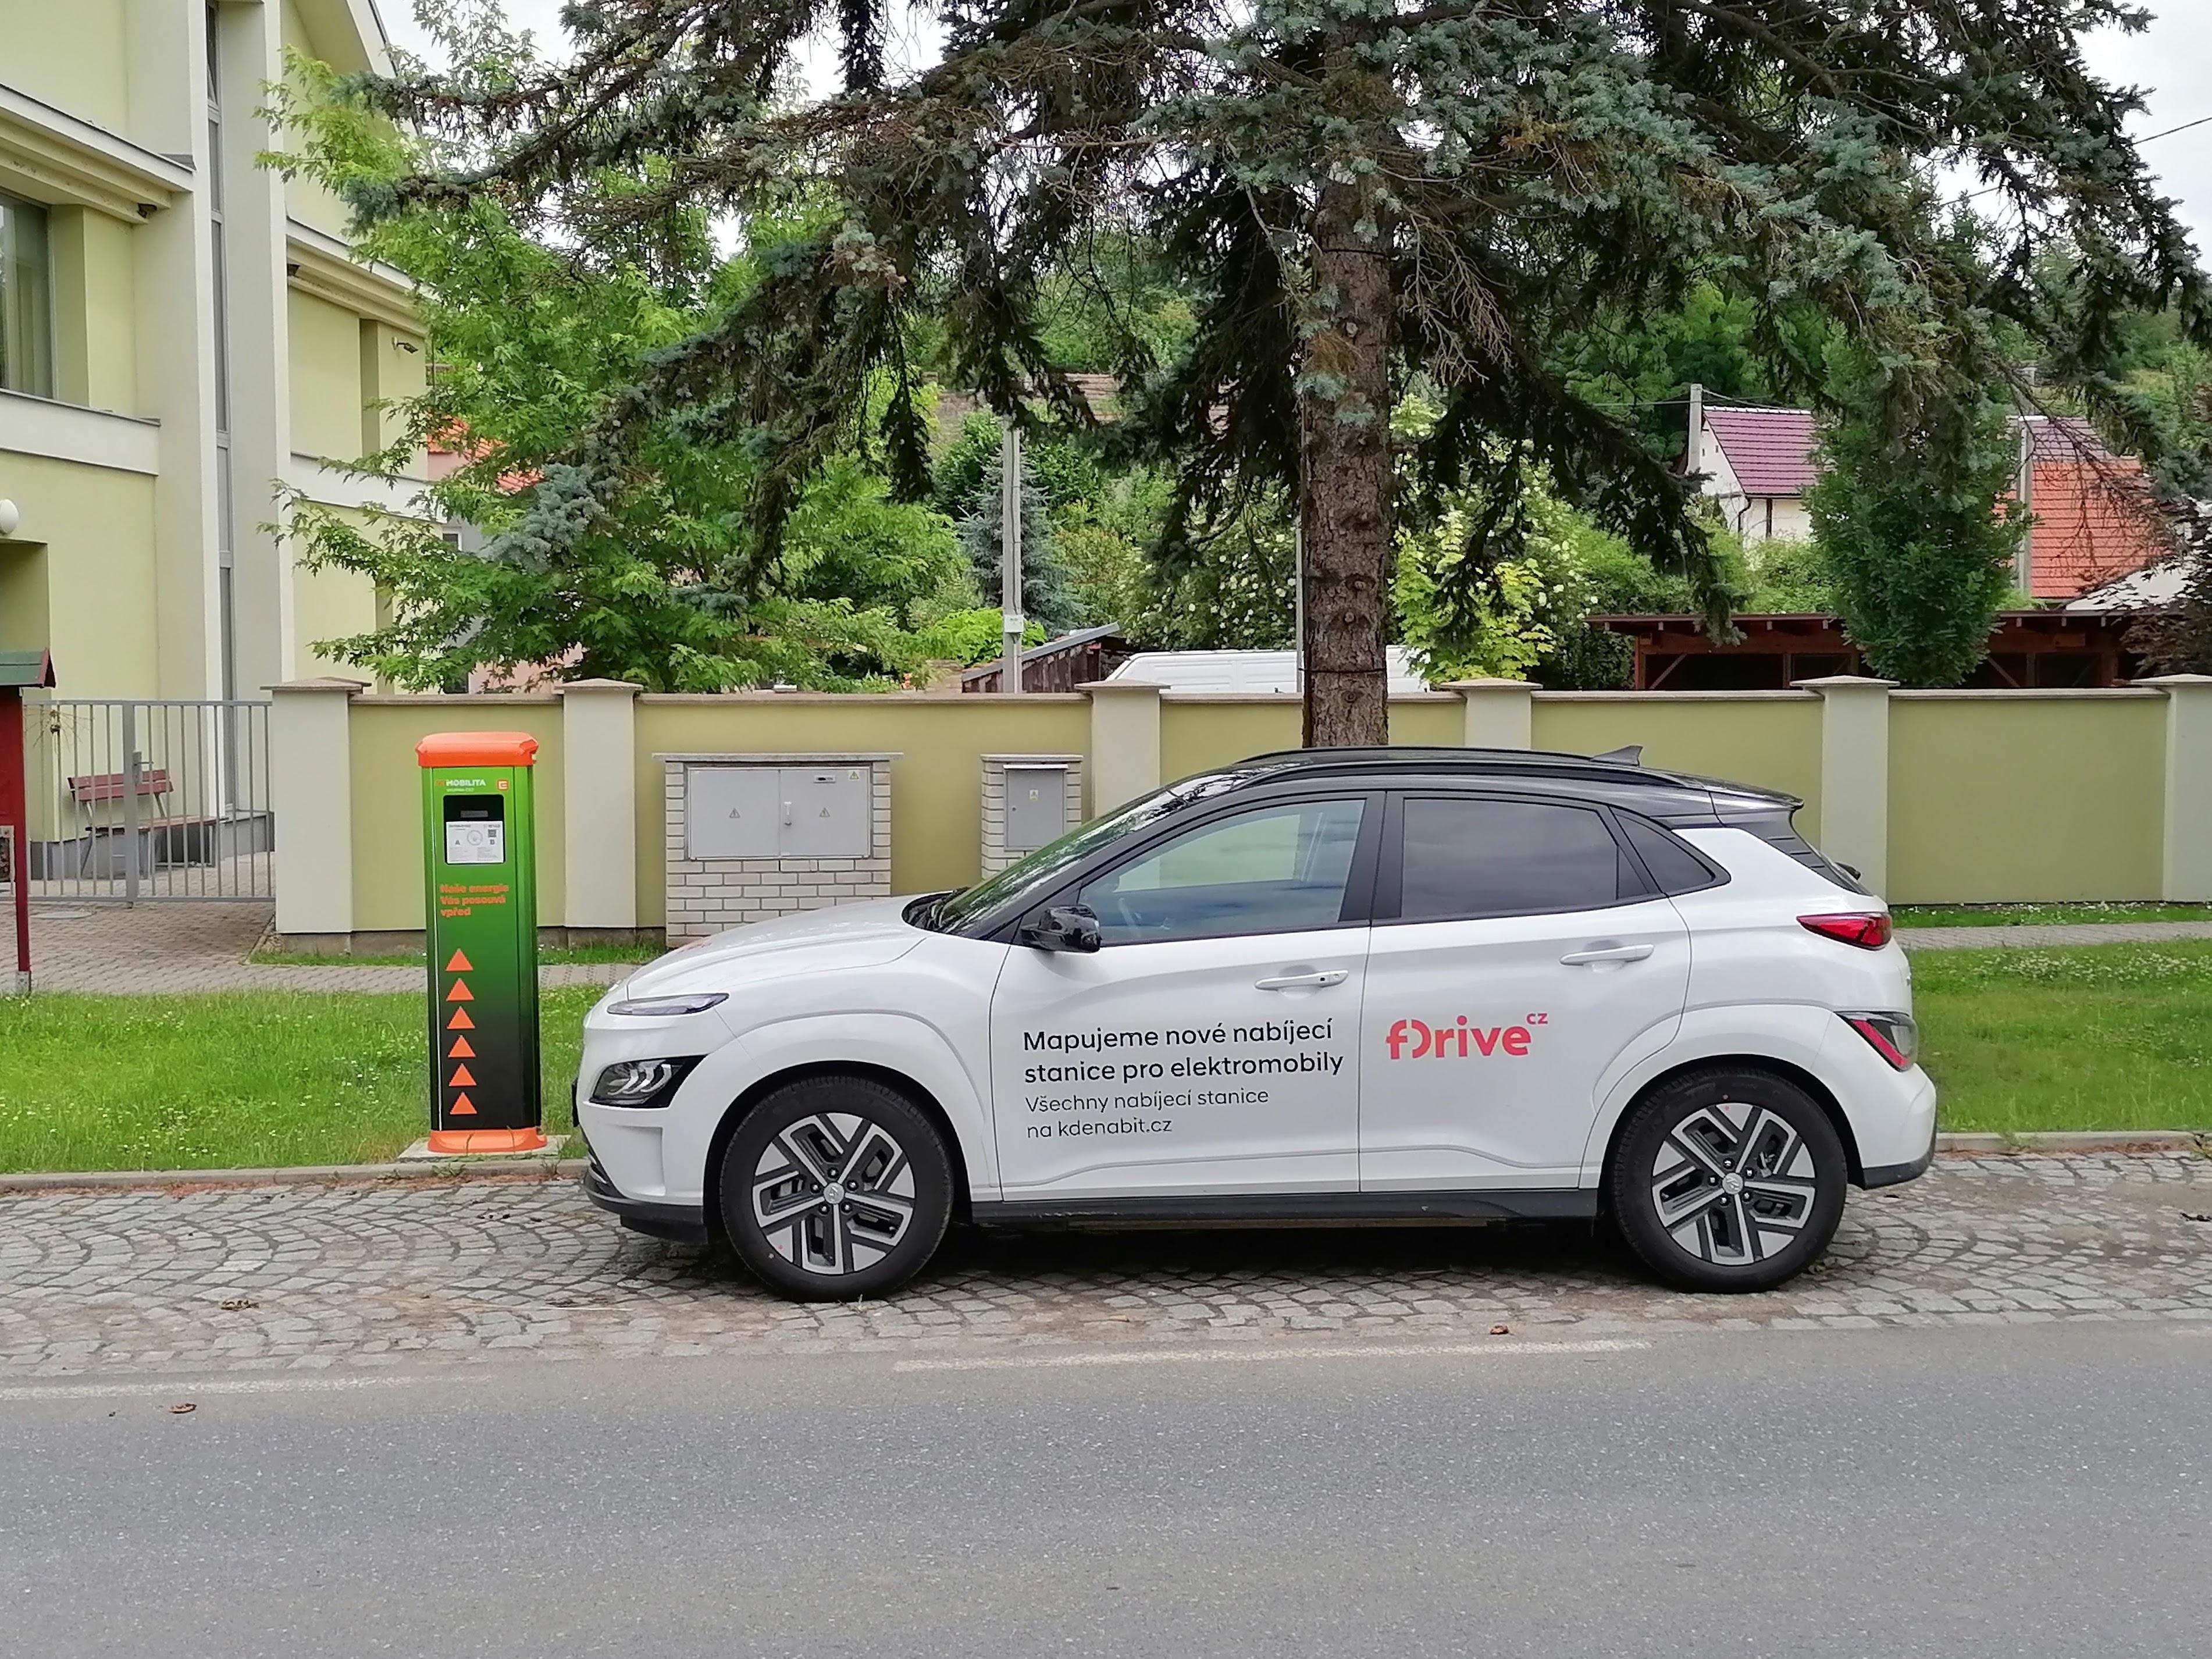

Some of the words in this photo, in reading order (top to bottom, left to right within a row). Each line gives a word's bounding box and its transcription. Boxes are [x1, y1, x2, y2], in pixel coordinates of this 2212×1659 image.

[1024, 1027, 1158, 1053] Mapujeme
[1166, 1023, 1226, 1045] nové
[1233, 1018, 1332, 1045] nabíjecí
[1025, 1062, 1115, 1083] stanice
[1123, 1063, 1163, 1084] pro
[1171, 1051, 1344, 1077] elektromobily
[1025, 1095, 1108, 1113] Všechny
[1114, 1089, 1191, 1110] nabíjecí
[1198, 1088, 1269, 1105] stanice
[1028, 1126, 1051, 1138] na
[1059, 1117, 1172, 1136] kdenabit.cz
